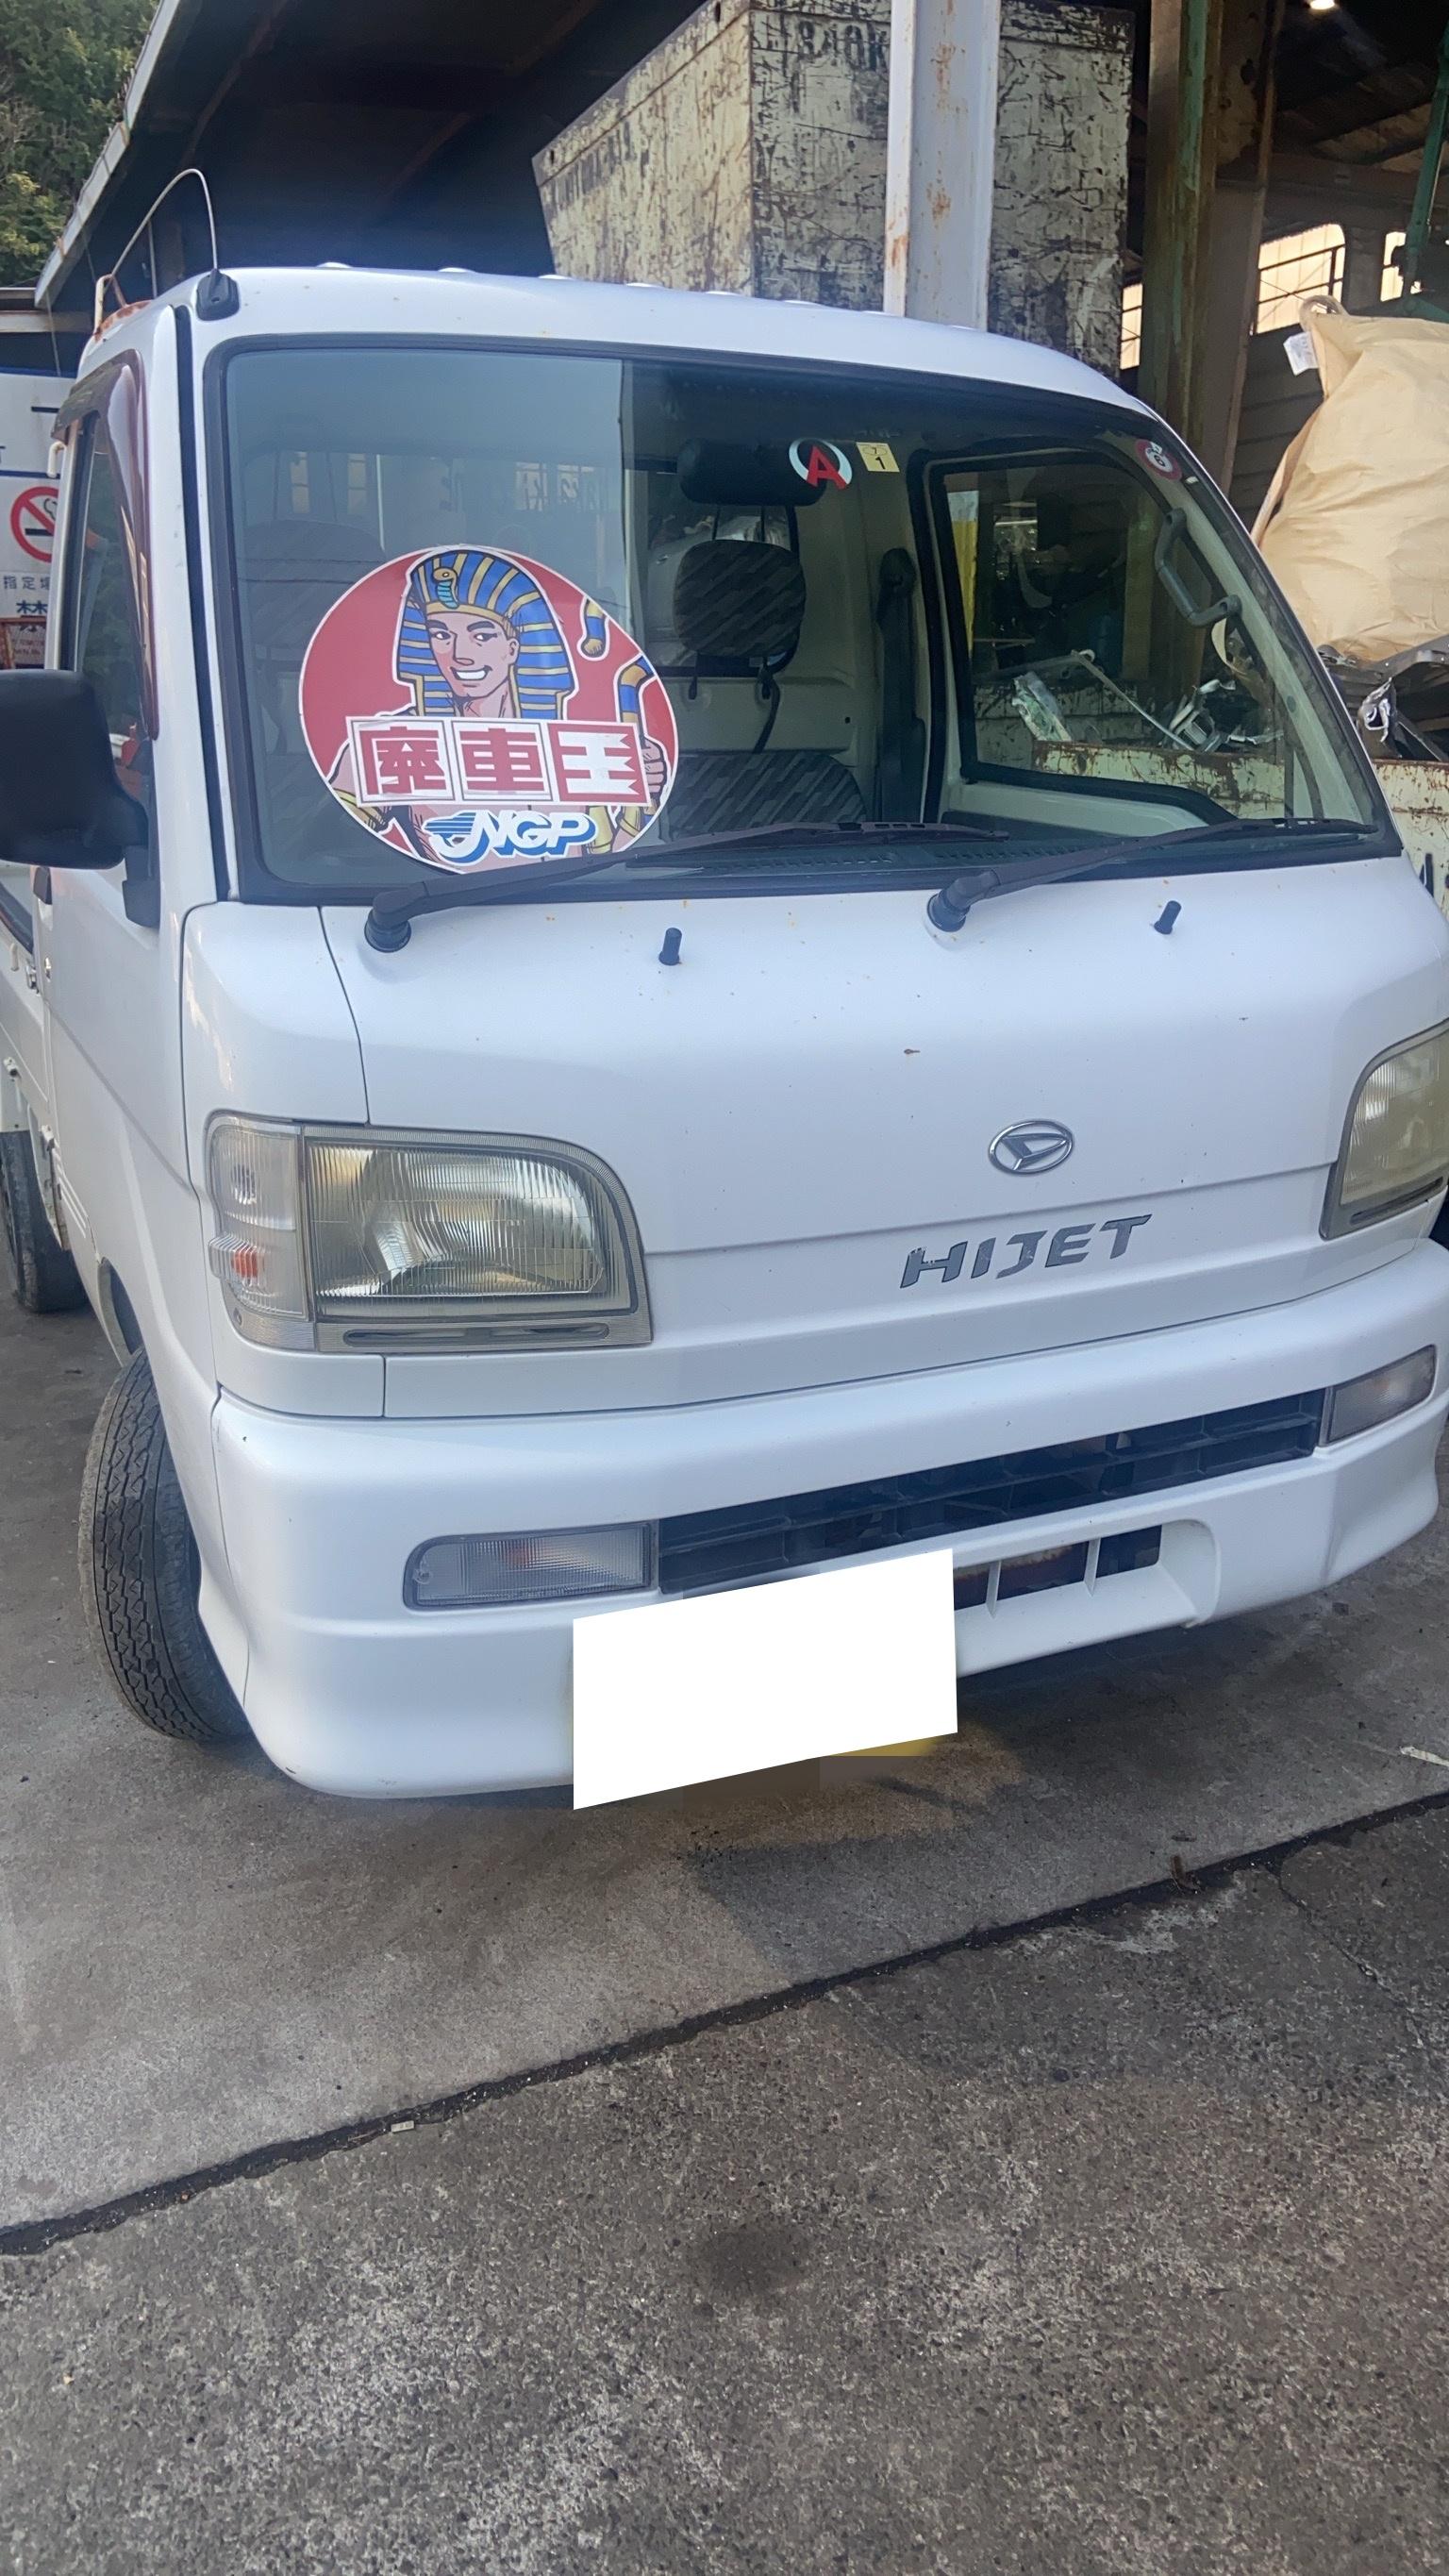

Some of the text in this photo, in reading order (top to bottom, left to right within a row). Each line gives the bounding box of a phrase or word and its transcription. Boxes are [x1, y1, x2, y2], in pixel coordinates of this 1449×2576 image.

[358, 725, 640, 795] 廃車王
[424, 810, 598, 865] NGP
[899, 1213, 1153, 1289] HIJET
